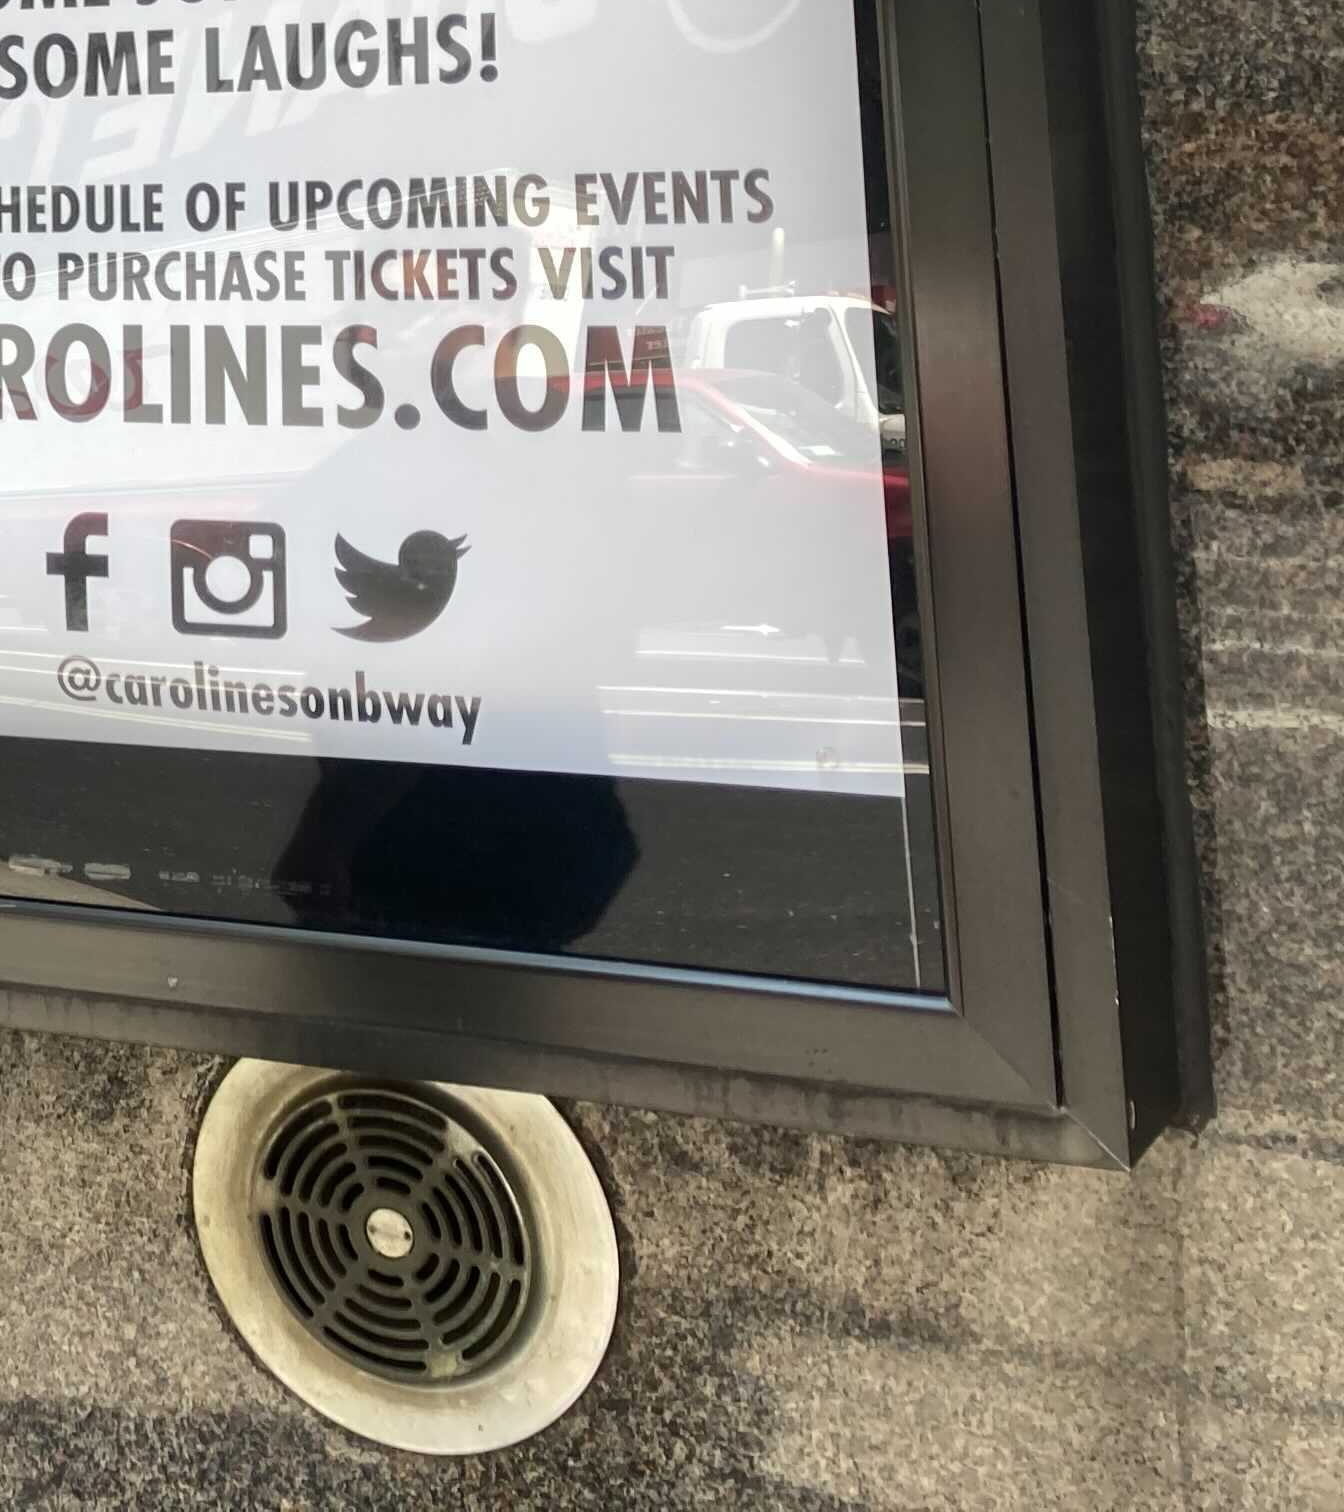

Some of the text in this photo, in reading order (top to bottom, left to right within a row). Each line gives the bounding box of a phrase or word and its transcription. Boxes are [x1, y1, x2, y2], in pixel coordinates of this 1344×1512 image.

[205, 12, 499, 93] LAUGHS!
[185, 181, 246, 233] OF
[268, 173, 551, 232] UPCOMING
[574, 168, 775, 227] EVENTS
[57, 250, 307, 302] PURCHASE
[324, 245, 518, 302] TICKETS
[534, 245, 676, 302] VISIT
[57, 655, 482, 745] @carolinesonbway
